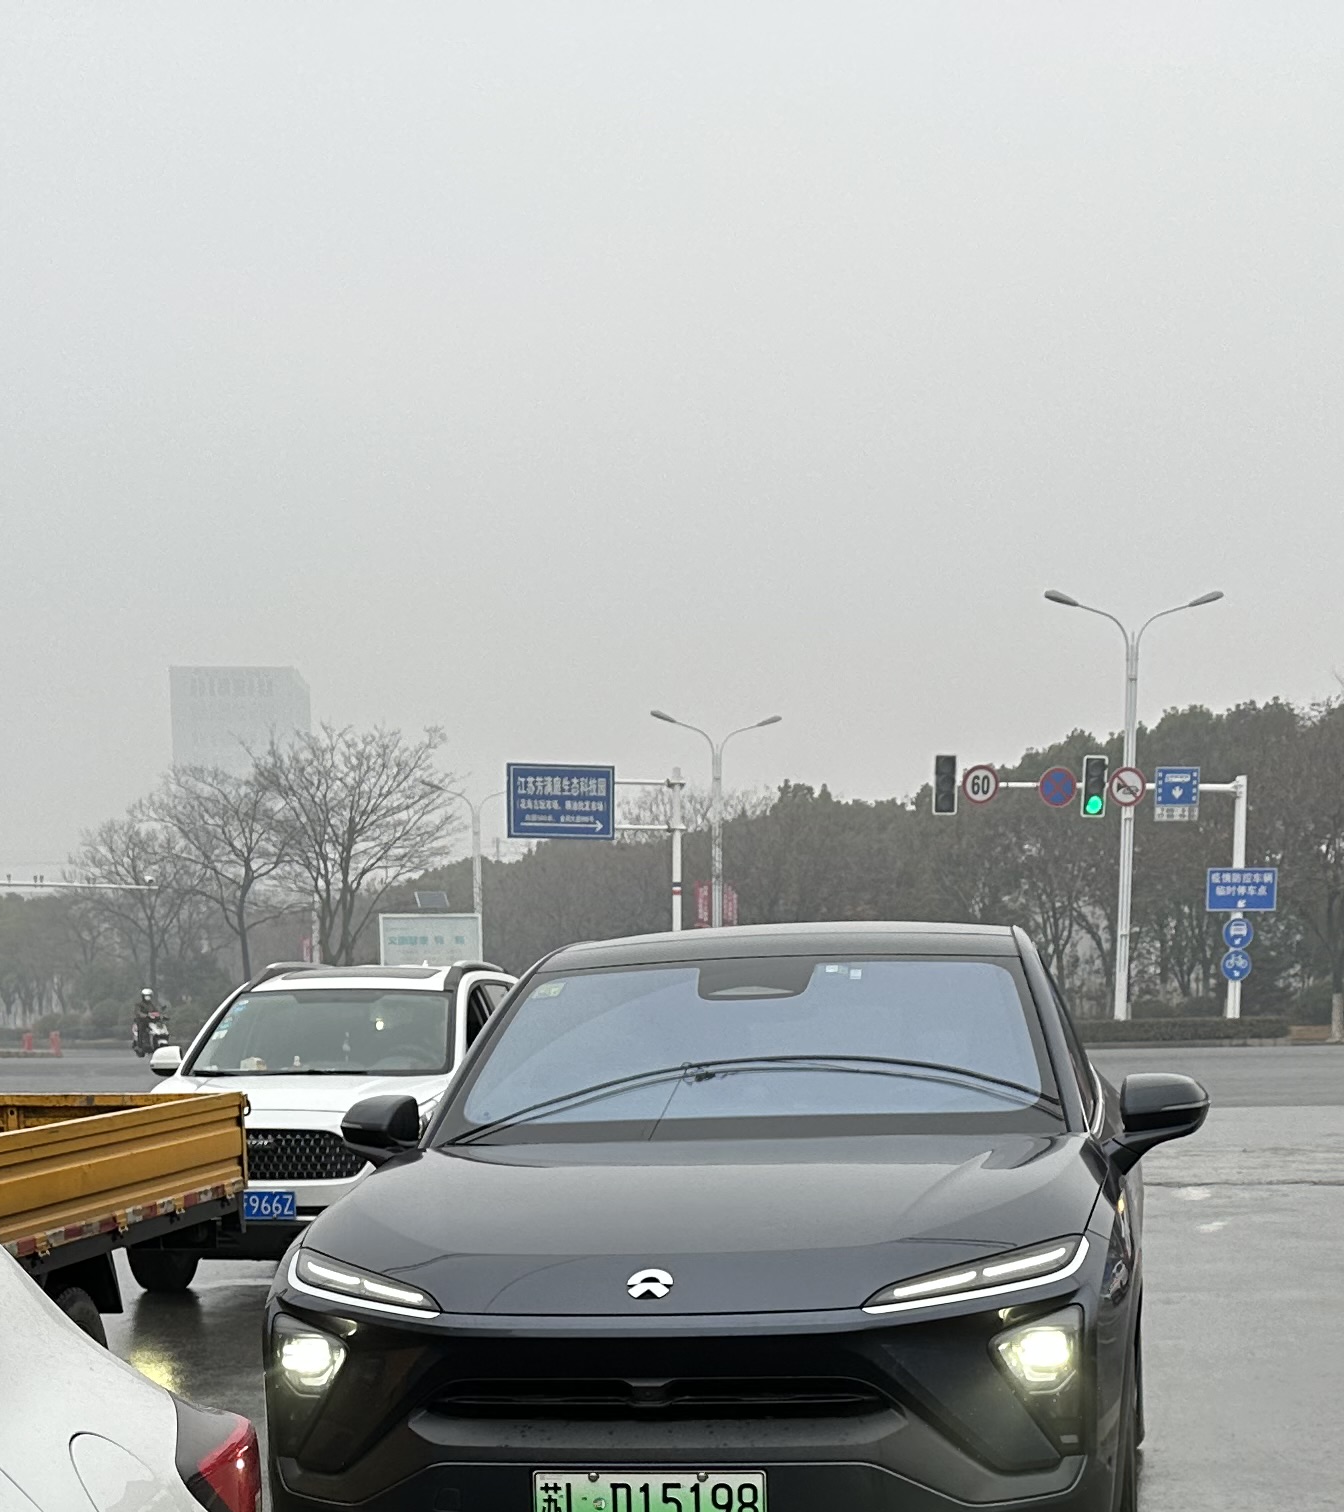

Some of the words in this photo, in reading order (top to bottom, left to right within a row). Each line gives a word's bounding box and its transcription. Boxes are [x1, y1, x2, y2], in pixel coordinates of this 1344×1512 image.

[971, 774, 990, 796] 60
[1215, 885, 1268, 897] 临时停车点
